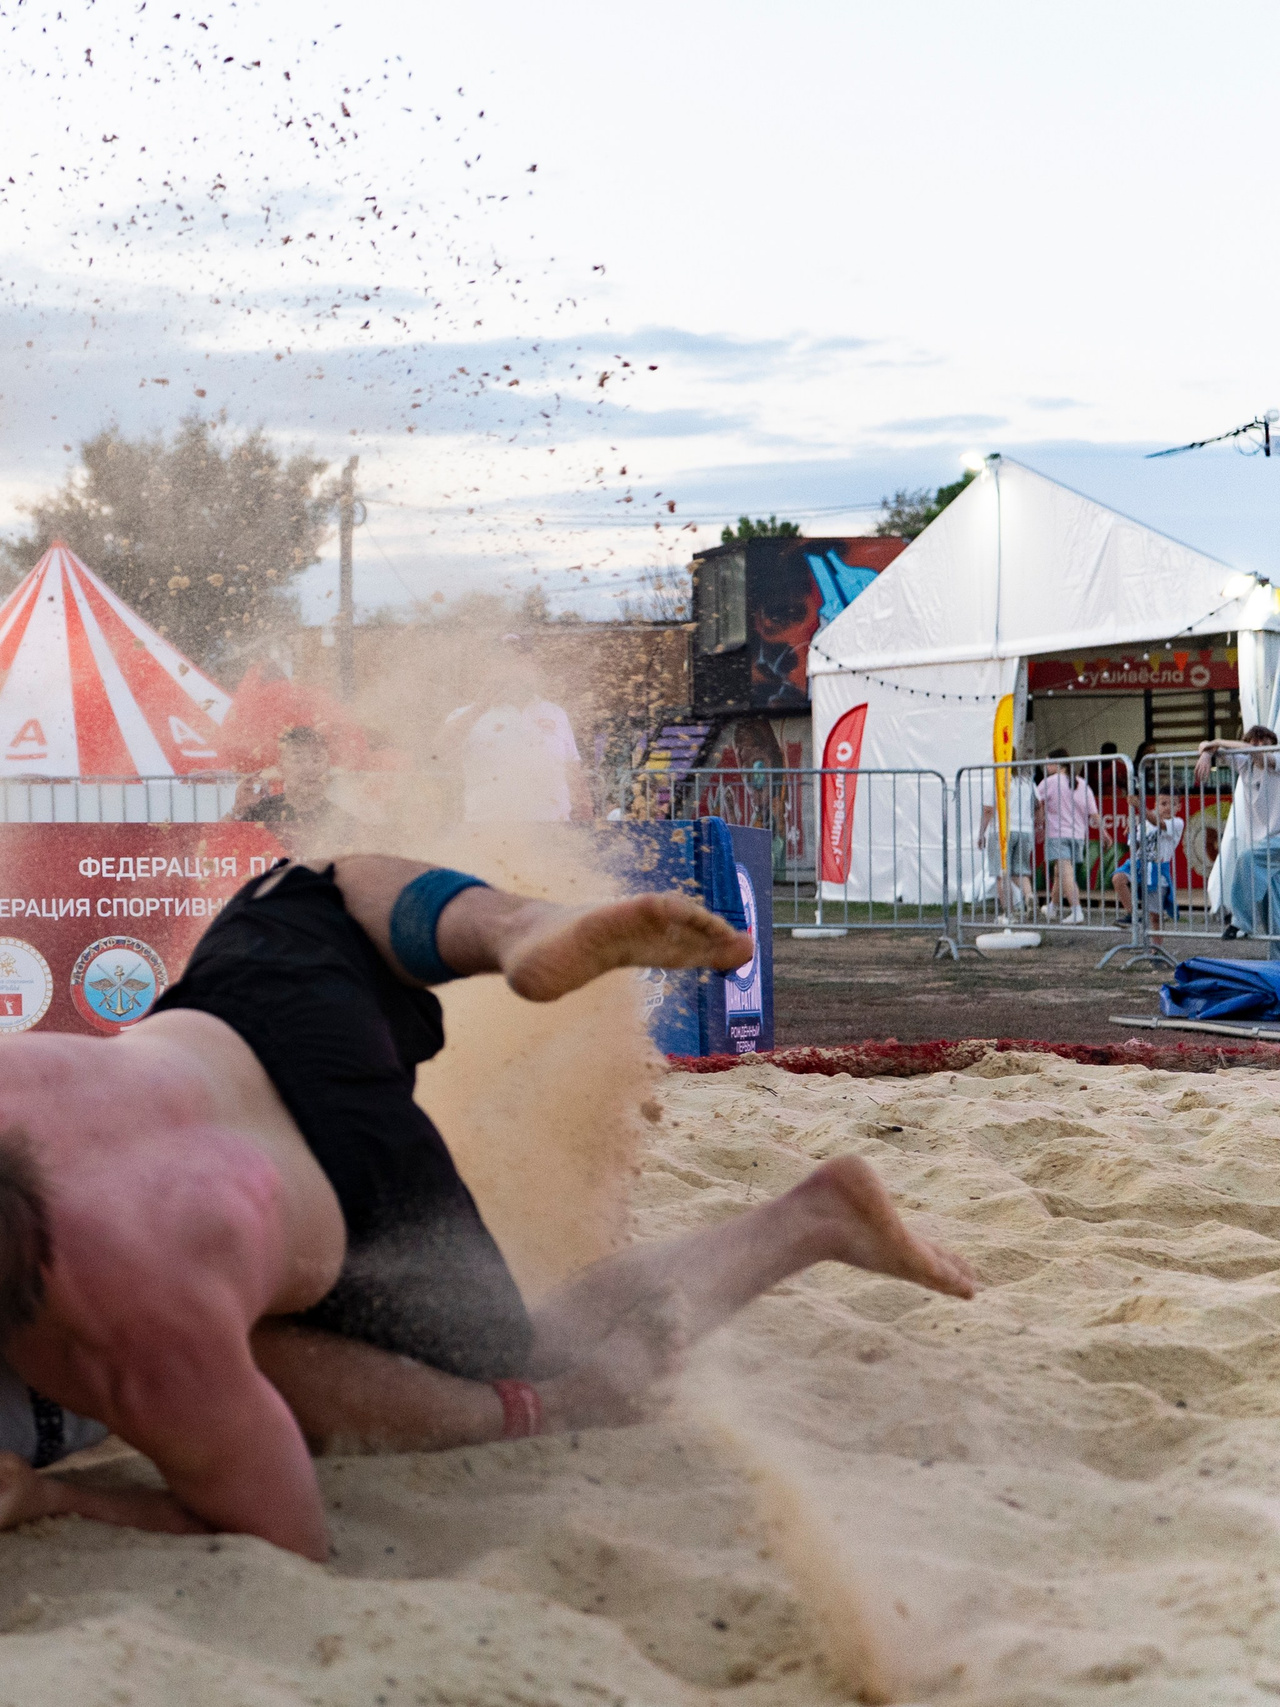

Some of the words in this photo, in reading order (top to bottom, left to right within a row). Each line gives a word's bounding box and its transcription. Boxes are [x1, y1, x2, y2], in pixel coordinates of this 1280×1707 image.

[78, 856, 237, 881] ФЕДЕРАЦИЯ
[96, 898, 228, 917] СПОРТИВН
[72, 937, 117, 984] ДОСААФ
